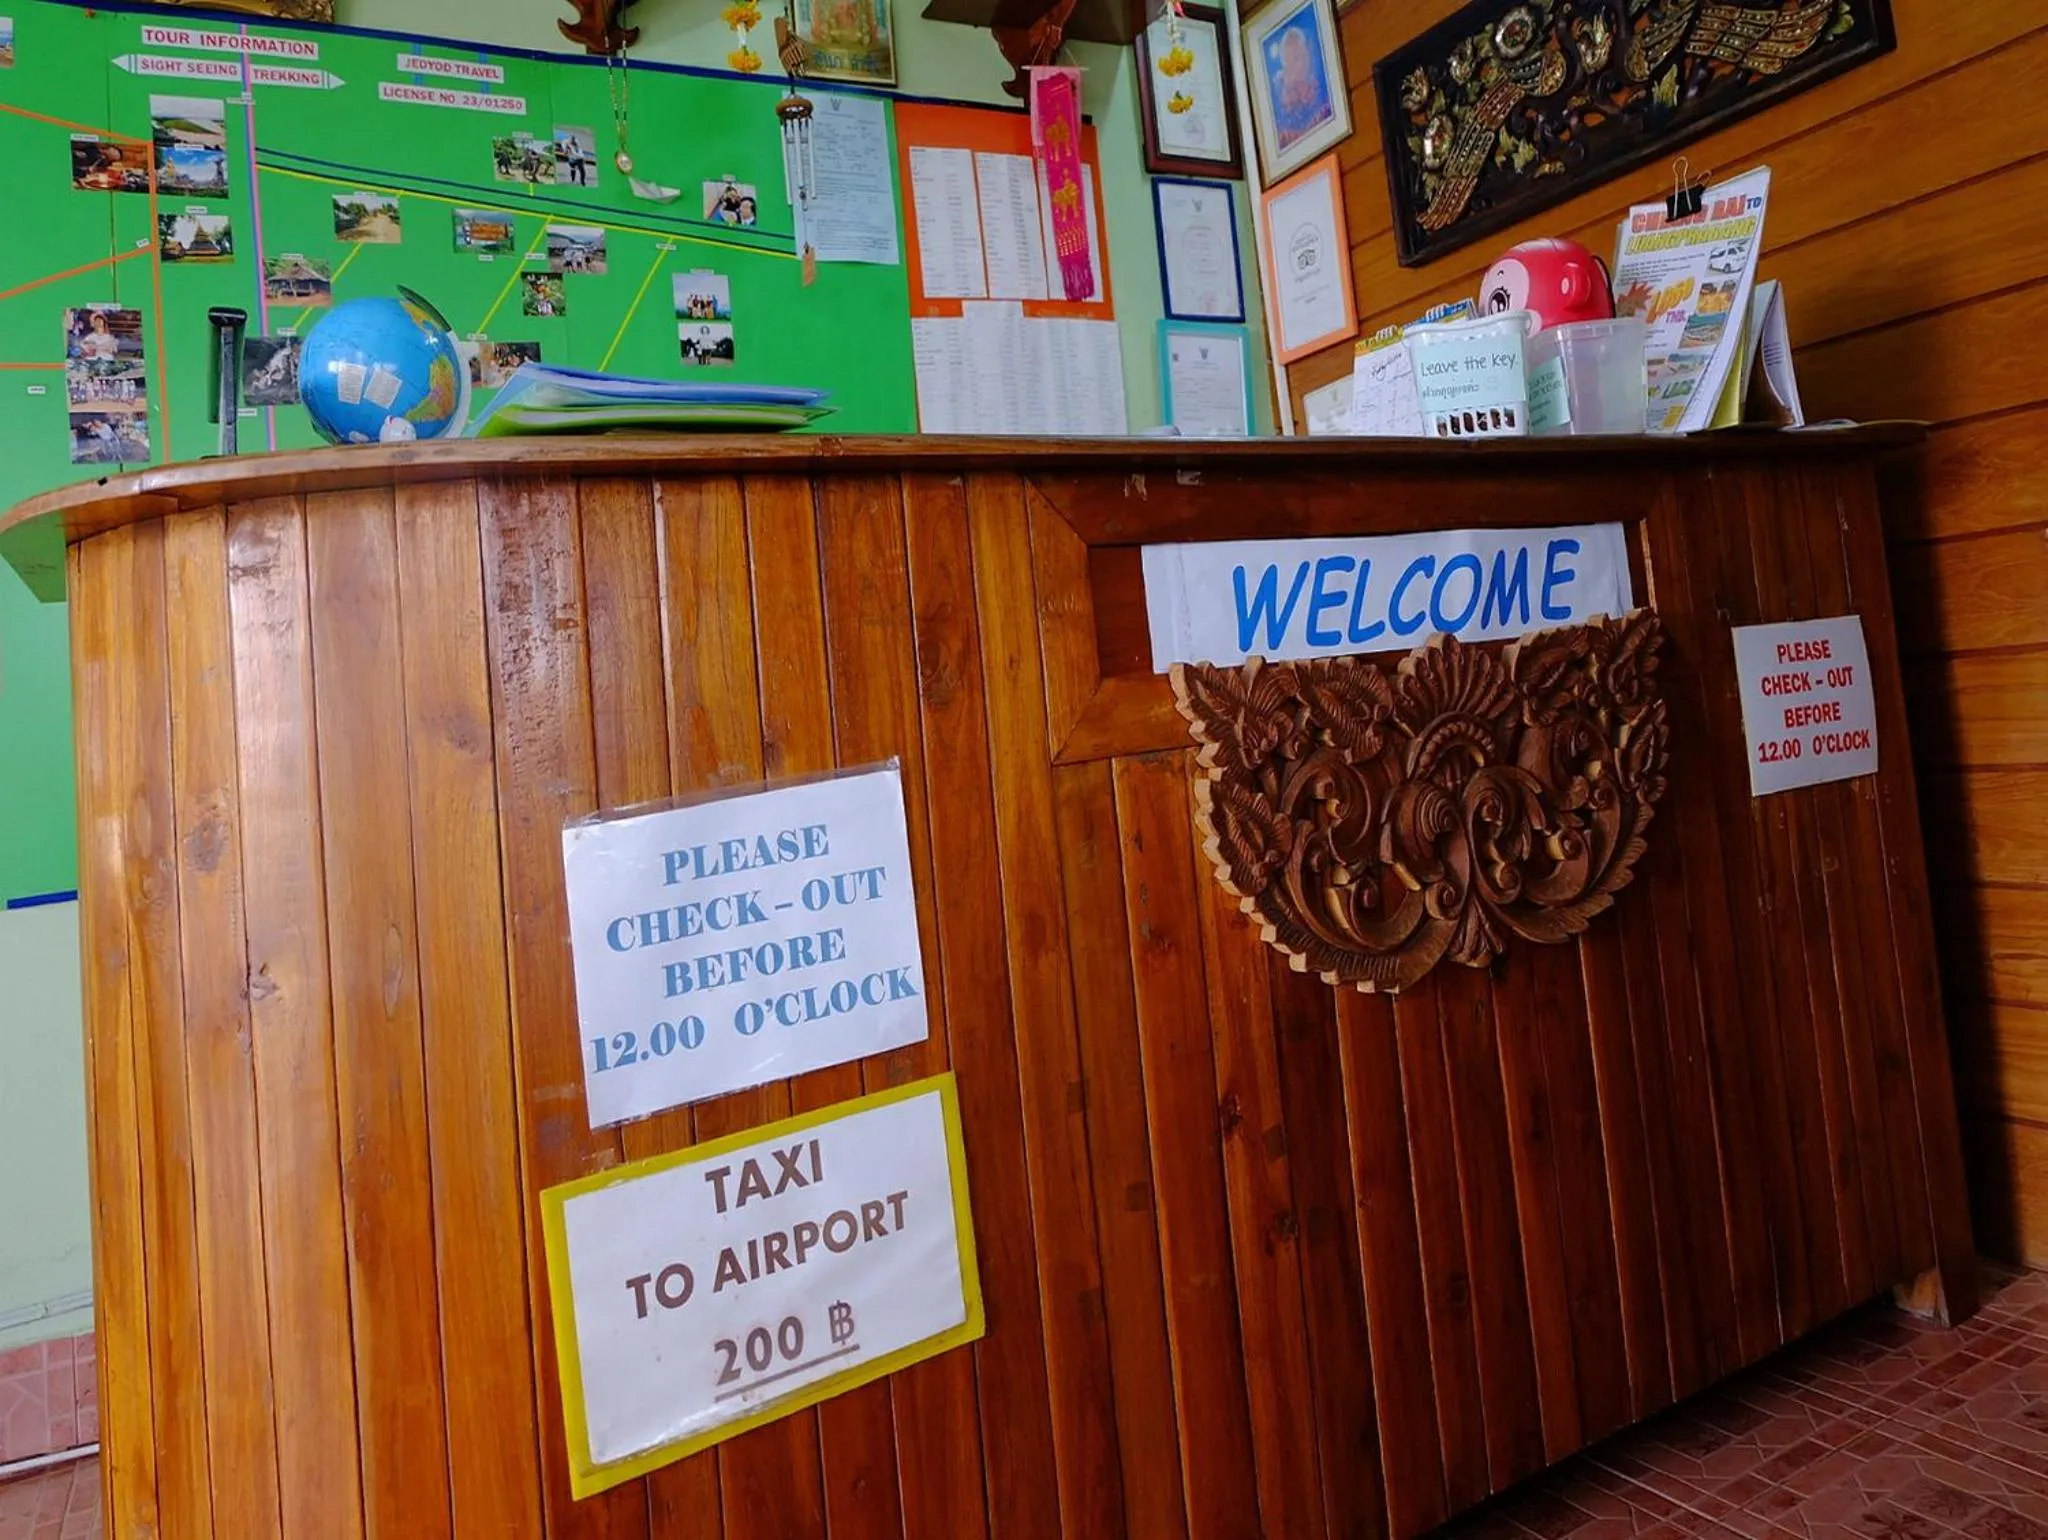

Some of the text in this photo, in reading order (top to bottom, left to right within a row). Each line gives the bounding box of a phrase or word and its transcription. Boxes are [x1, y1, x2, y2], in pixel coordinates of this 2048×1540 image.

[144, 29, 315, 55] TOUR INFORMATION
[141, 59, 238, 76] SIGHT SEEING
[252, 69, 320, 85] TREKKING
[455, 64, 500, 79] TRAVEL
[383, 86, 436, 101] LICENSE
[1421, 360, 1458, 377] Leave
[1464, 356, 1487, 370] the
[1232, 539, 1580, 653] WELCOME
[1776, 639, 1832, 664] PLEASE
[1784, 702, 1842, 729] BEFORE
[1758, 730, 1871, 763] 12.00 O'CLOCK
[660, 823, 831, 887] PLEASE
[661, 927, 847, 999] BEFORE
[589, 965, 920, 1075] 12.00 O'CLOCK
[704, 1138, 824, 1214] TAXI
[625, 1190, 909, 1319] TO AIRPORT
[713, 1315, 804, 1387] 200
